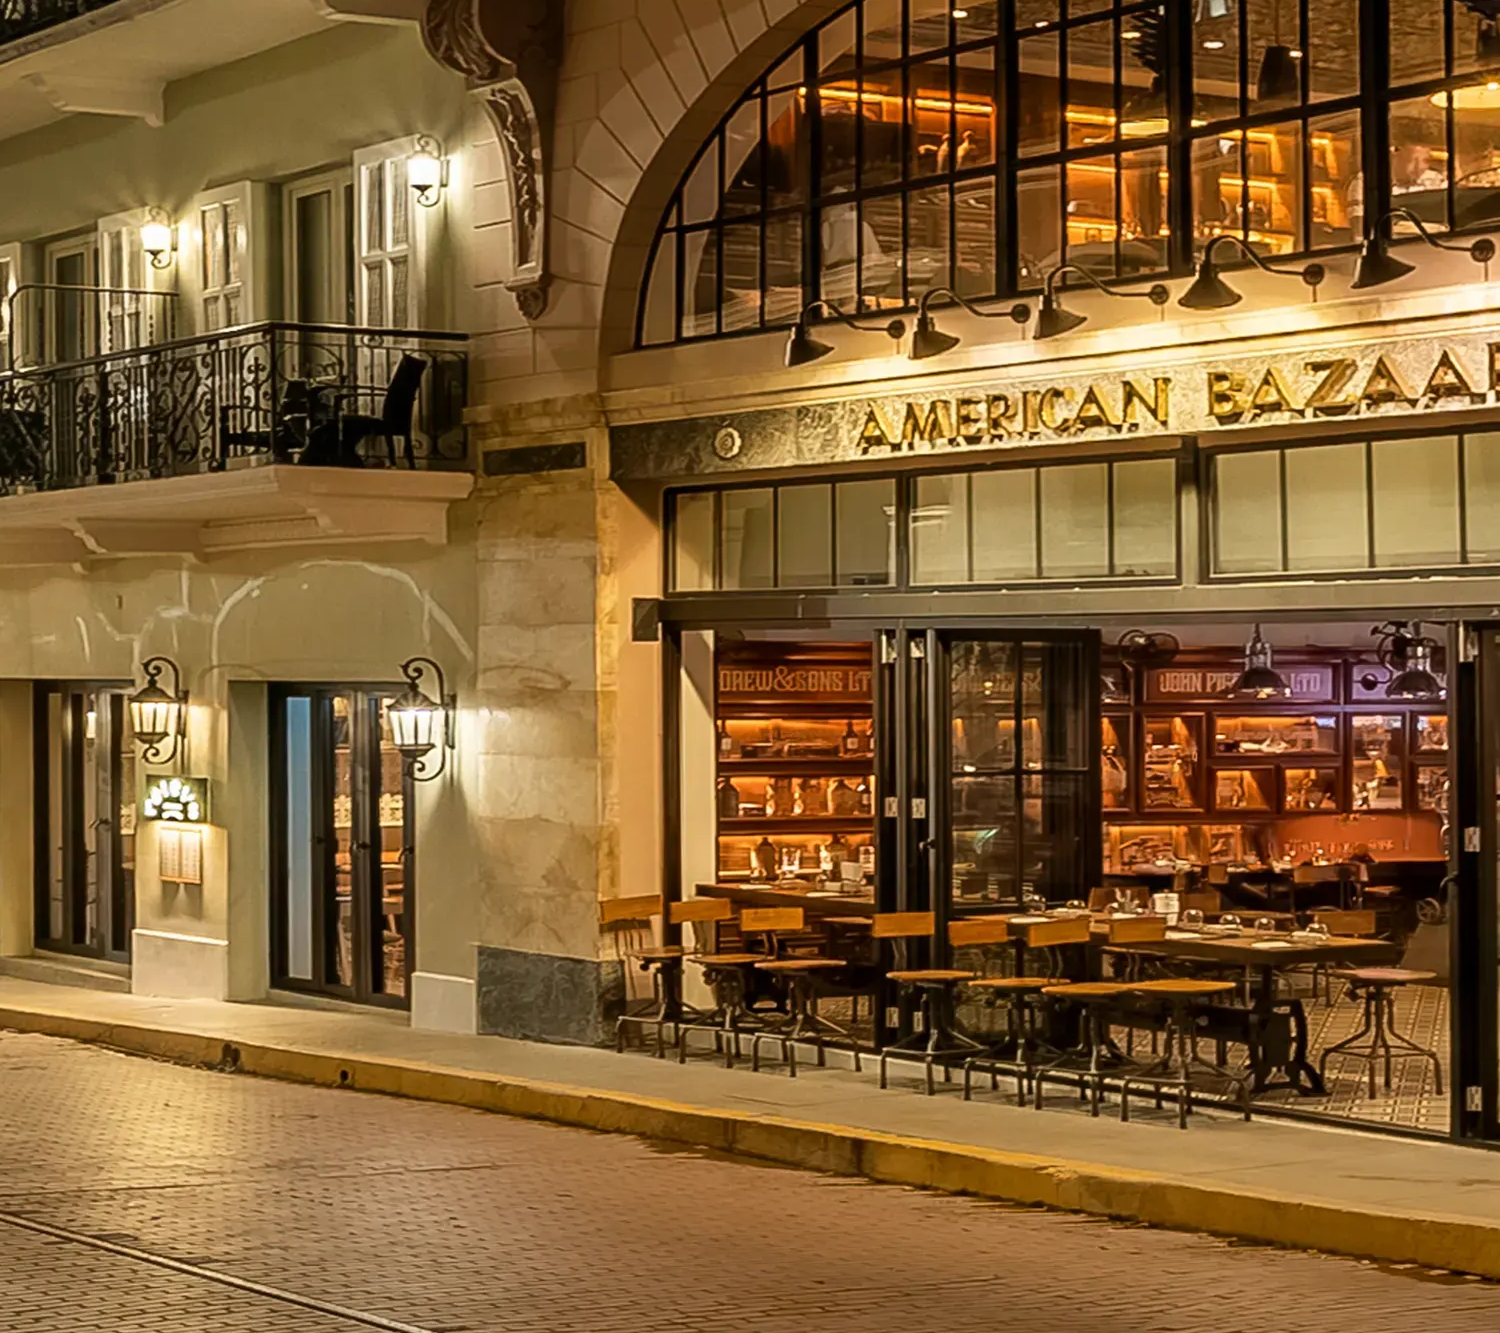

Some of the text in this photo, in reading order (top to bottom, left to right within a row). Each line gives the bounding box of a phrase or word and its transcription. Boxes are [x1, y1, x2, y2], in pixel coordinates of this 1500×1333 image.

[856, 377, 1172, 449] AMERICAN
[1160, 672, 1202, 693] JOHN
[1290, 673, 1320, 693] LTD
